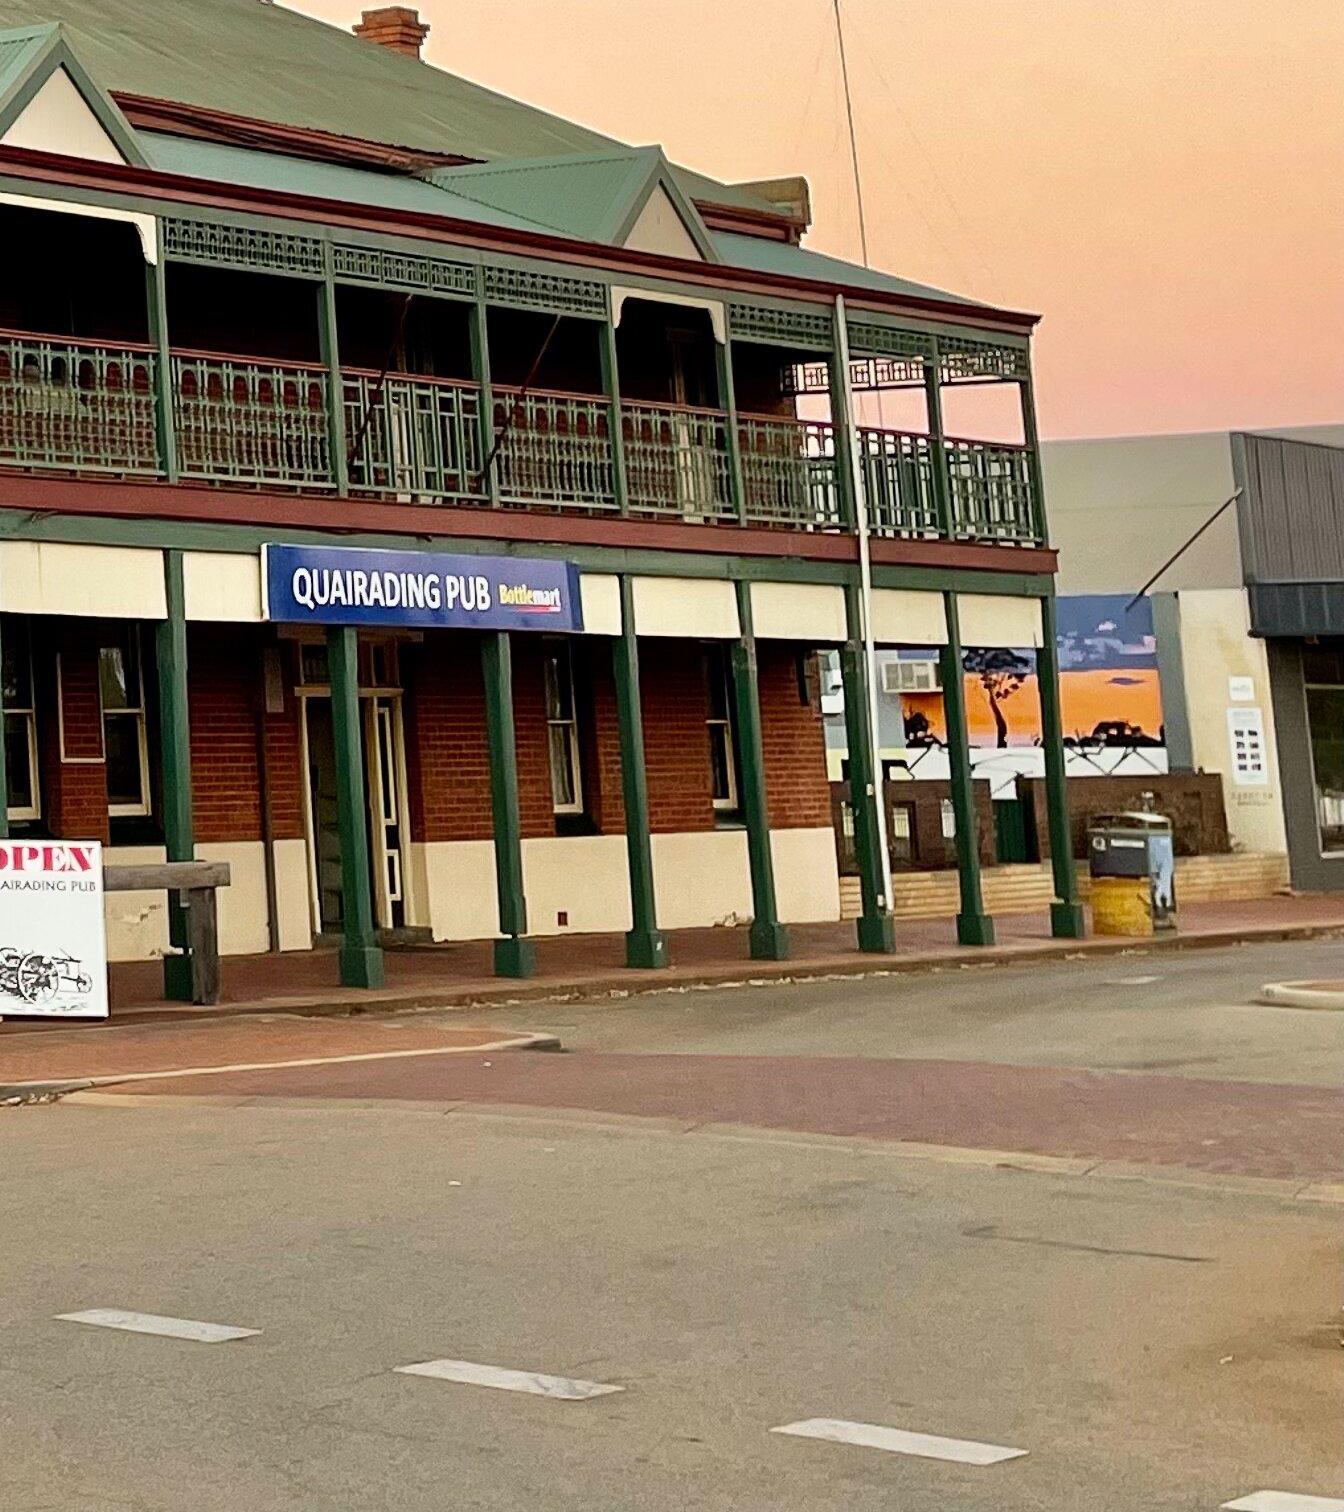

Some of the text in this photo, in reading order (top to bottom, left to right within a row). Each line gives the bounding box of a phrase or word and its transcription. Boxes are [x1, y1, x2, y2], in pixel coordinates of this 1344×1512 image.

[292, 568, 491, 611] QUAIRADING PUB
[499, 584, 561, 606] Bottlemart
[71, 880, 96, 892] PUB
